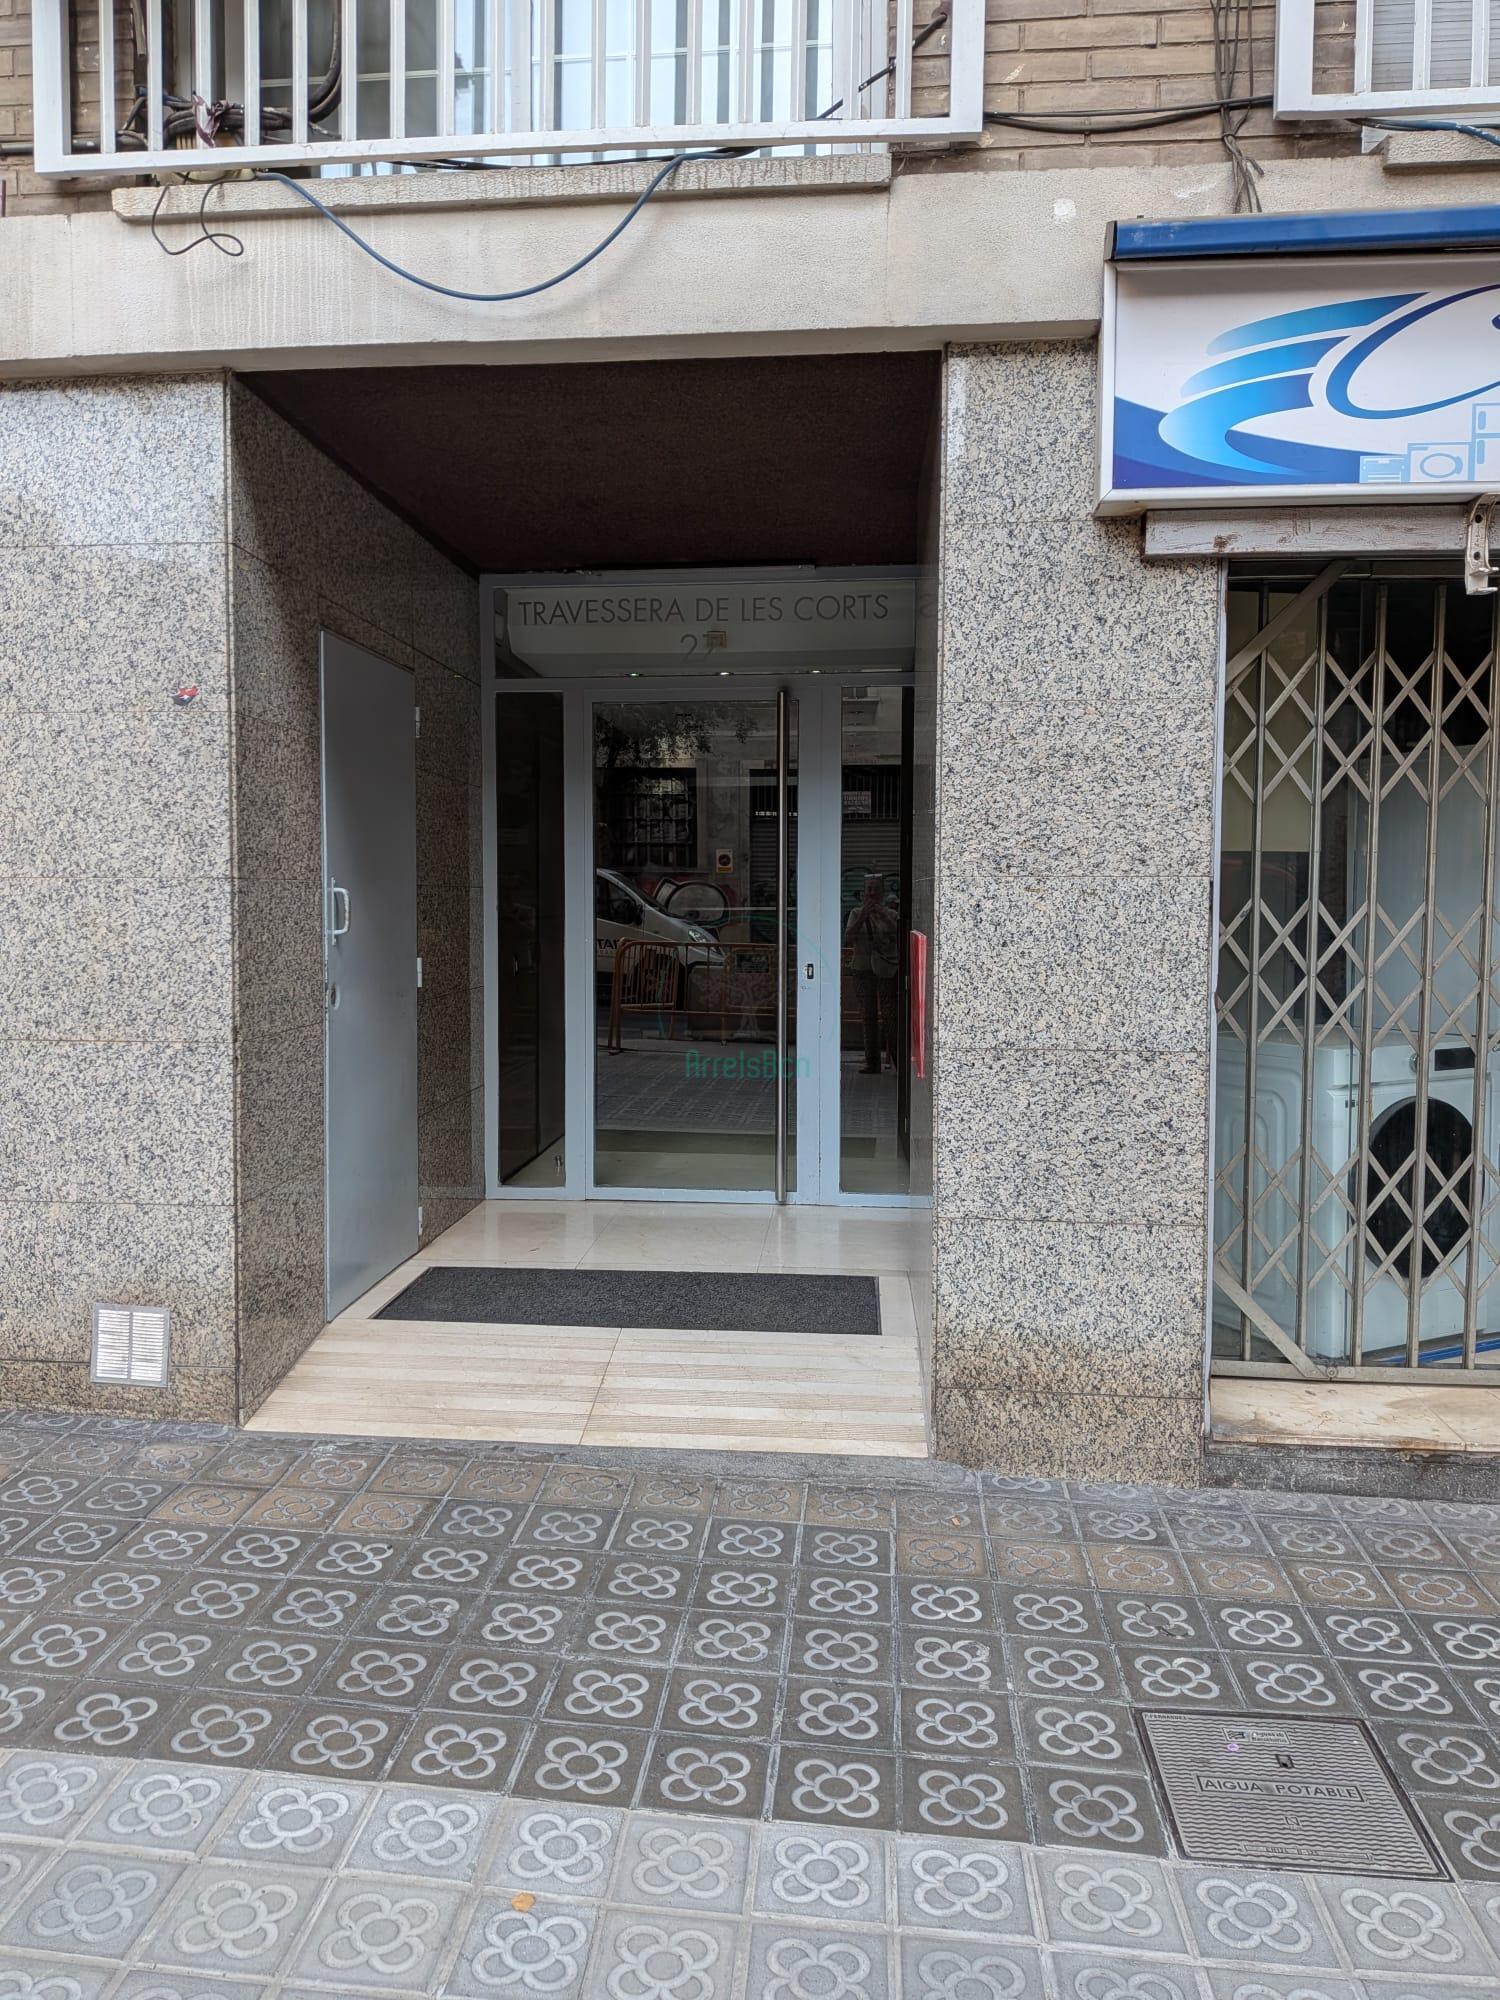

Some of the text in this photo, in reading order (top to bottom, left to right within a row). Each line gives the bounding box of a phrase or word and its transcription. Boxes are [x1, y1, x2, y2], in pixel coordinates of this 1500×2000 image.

[518, 594, 889, 626] TRAVESSERA DE LES CORTS
[1204, 1779, 1359, 1799] AIGUA POTABLE
